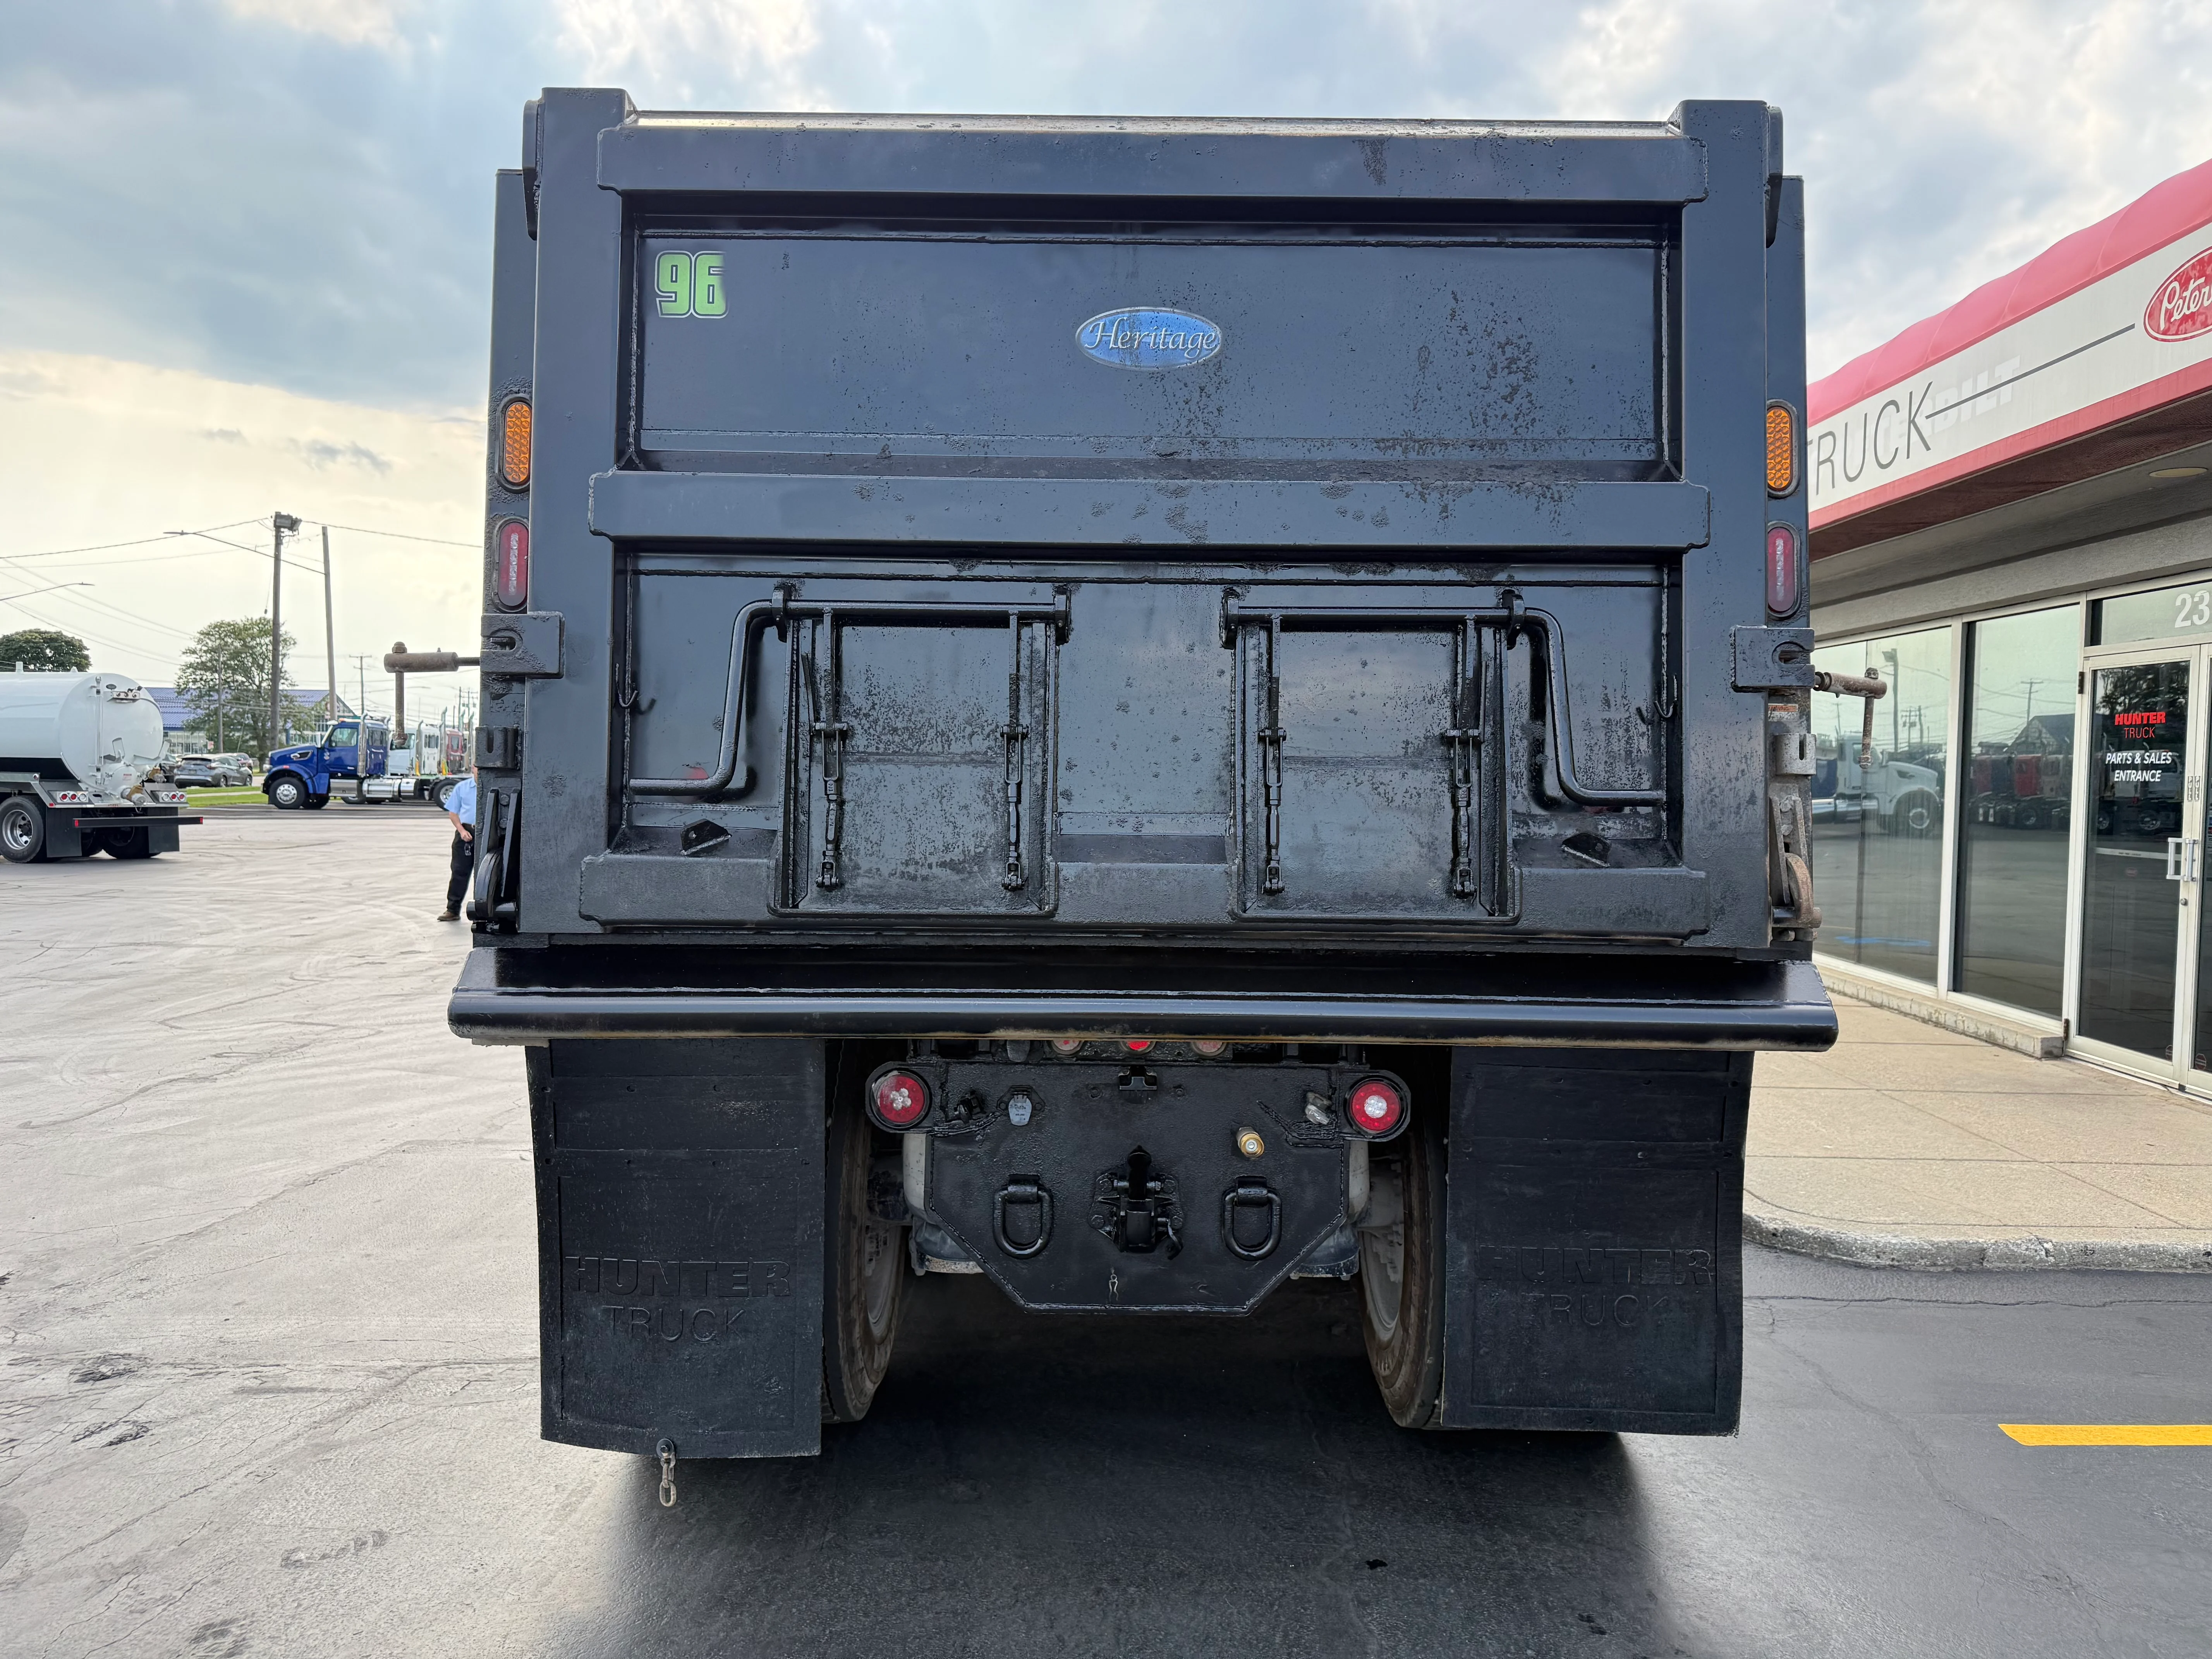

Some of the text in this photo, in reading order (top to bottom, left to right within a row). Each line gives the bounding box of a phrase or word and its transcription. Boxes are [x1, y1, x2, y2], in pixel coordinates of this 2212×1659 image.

[654, 250, 729, 319] 96
[2160, 276, 2212, 331] Peter
[1084, 317, 1216, 359] Heritage
[1808, 381, 1933, 495] RUCK
[2175, 590, 2212, 628] 23
[2115, 712, 2166, 725] HUNTER
[2124, 727, 2155, 738] TRUCK
[2106, 752, 2172, 764] PARTS & SALES
[2114, 770, 2162, 781] ENTRANCE
[565, 1256, 791, 1297] HUNTER
[1479, 1245, 1712, 1285] HUNTER
[601, 1305, 746, 1343] TRUCK
[1521, 1293, 1669, 1326] TRUCK
